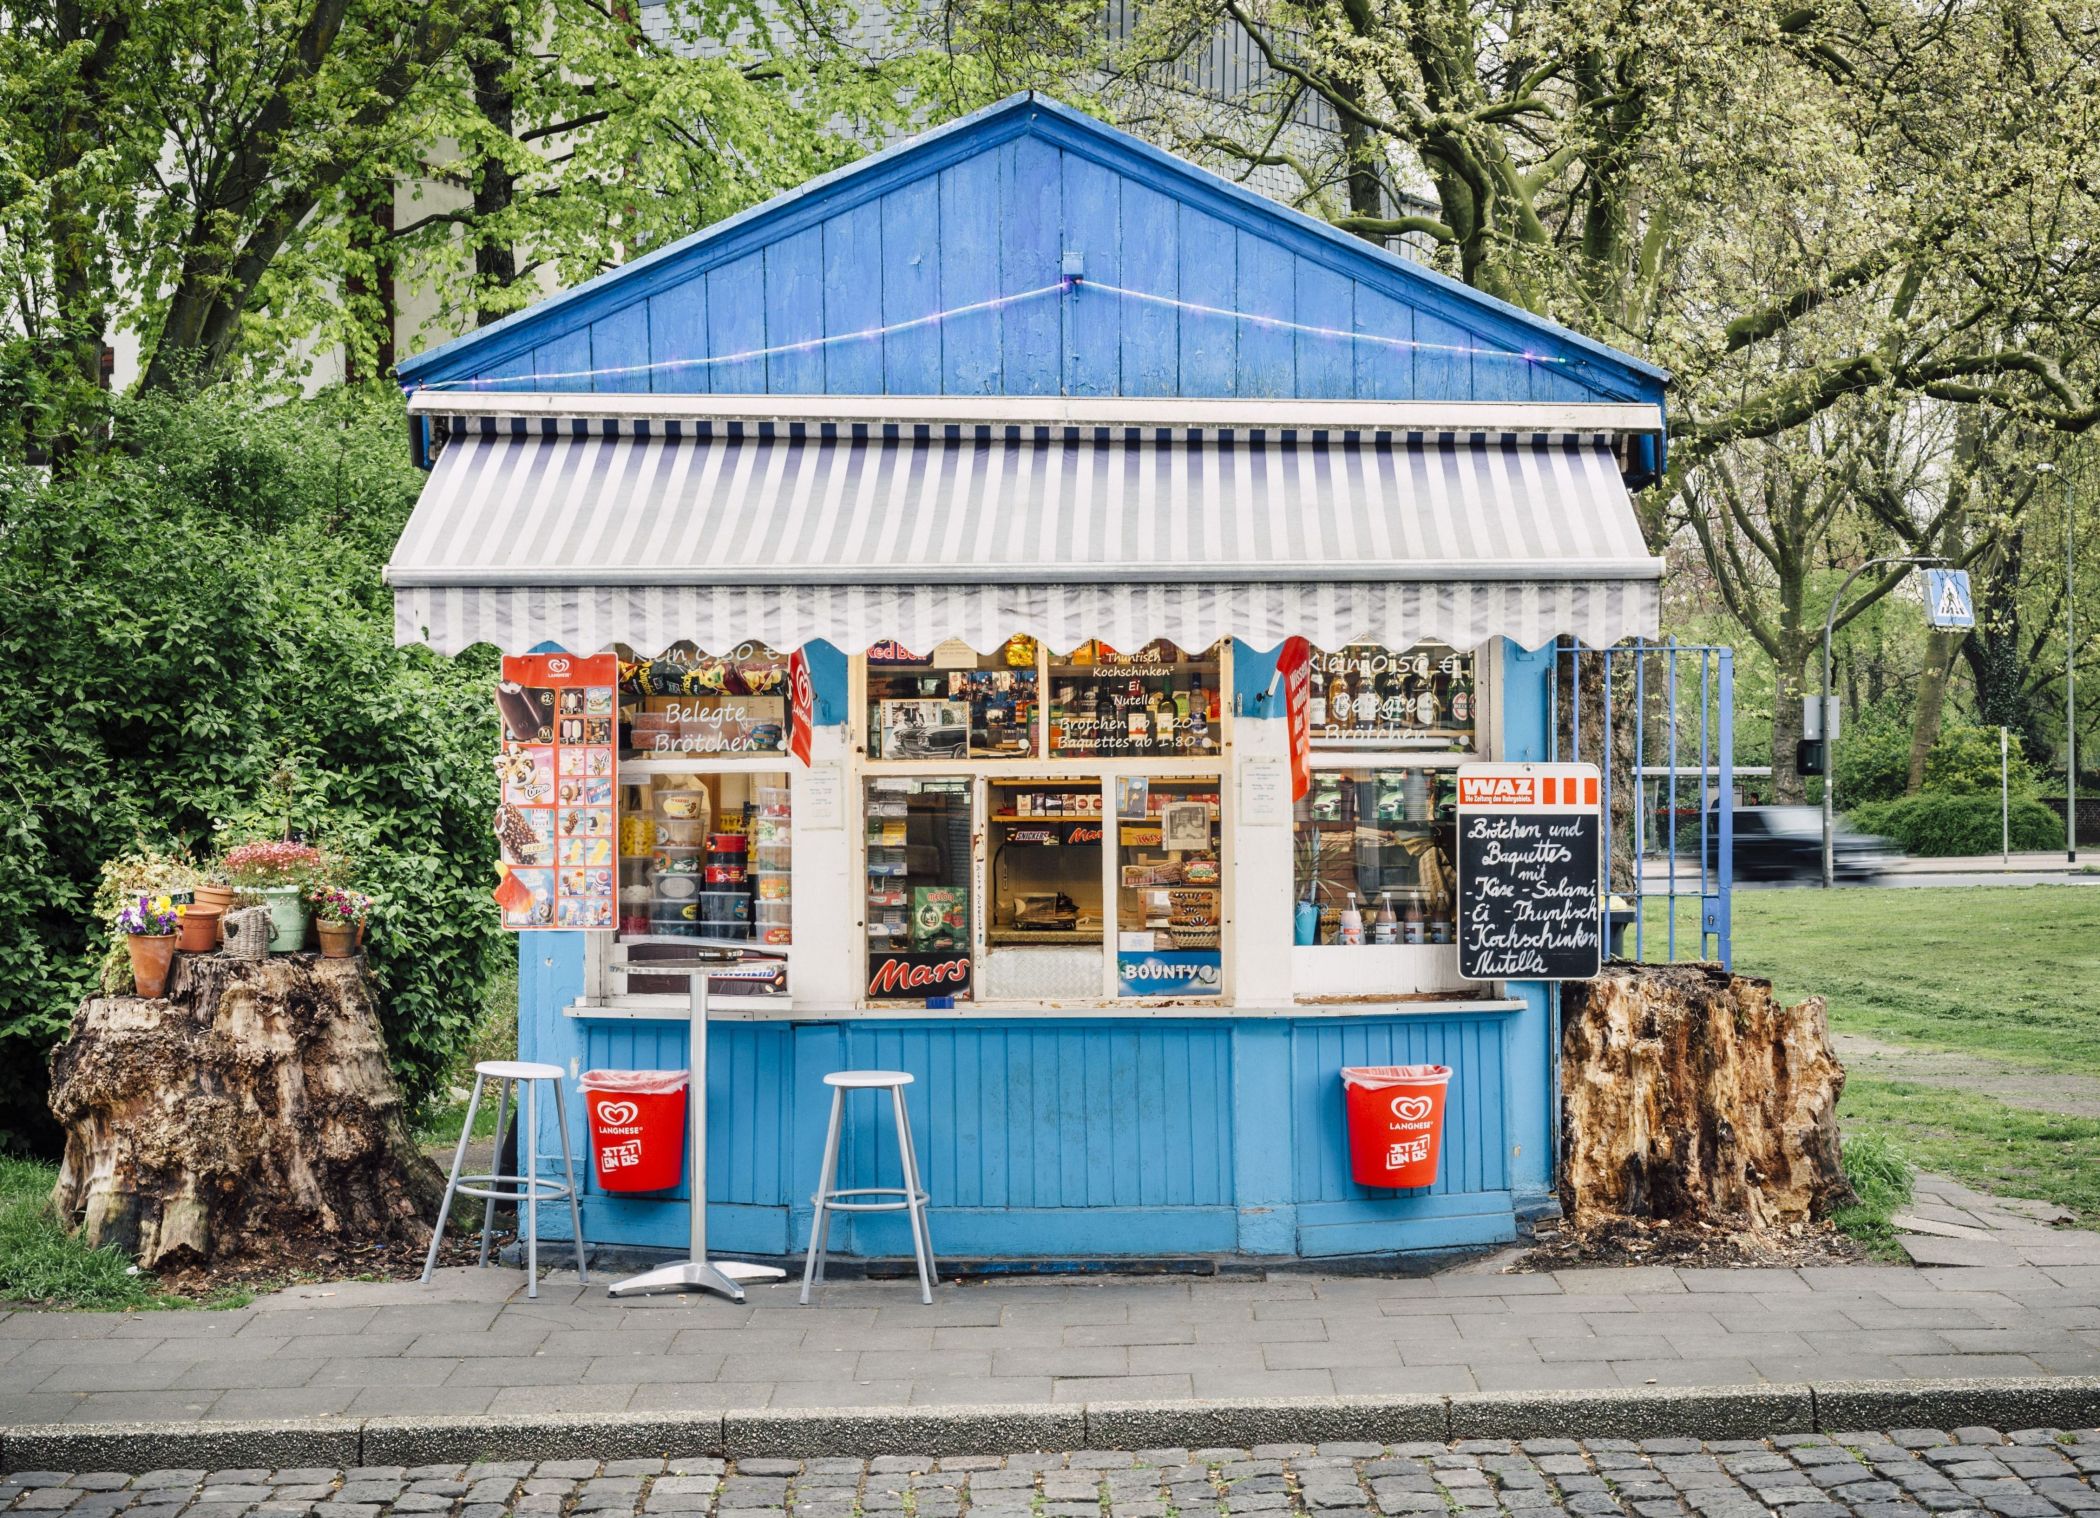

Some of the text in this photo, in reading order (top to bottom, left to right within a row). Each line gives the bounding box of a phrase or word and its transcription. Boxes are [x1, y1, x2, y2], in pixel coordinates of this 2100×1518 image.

[1128, 680, 1141, 692] Ei
[1114, 694, 1155, 705] Nutella
[1335, 693, 1417, 720] Beegte
[666, 701, 746, 728] Belegte
[1060, 717, 1127, 730] Brötchen
[1325, 722, 1427, 742] Brötchen
[655, 731, 757, 753] Brötchen
[1135, 737, 1152, 748] ab
[1159, 737, 1196, 749] 1,80
[1463, 779, 1532, 795] WAZ
[1474, 795, 1492, 804] Zeitung
[1468, 816, 1584, 839] Brötchen und
[1518, 864, 1547, 880] mit
[1475, 876, 1515, 900] Käse
[1532, 876, 1596, 899] Salami
[1472, 903, 1490, 922] Ei
[1513, 897, 1598, 930] Thunfisch
[1469, 921, 1598, 951] Kochschinken
[1472, 949, 1548, 975] Nutella
[869, 959, 970, 995] Mars
[1125, 964, 1198, 979] BOUNTY
[599, 1126, 640, 1135] LANGNESE
[1390, 1122, 1431, 1130] LANGNESE
[602, 1144, 638, 1157] JETZT
[1390, 1140, 1428, 1154] JETZT
